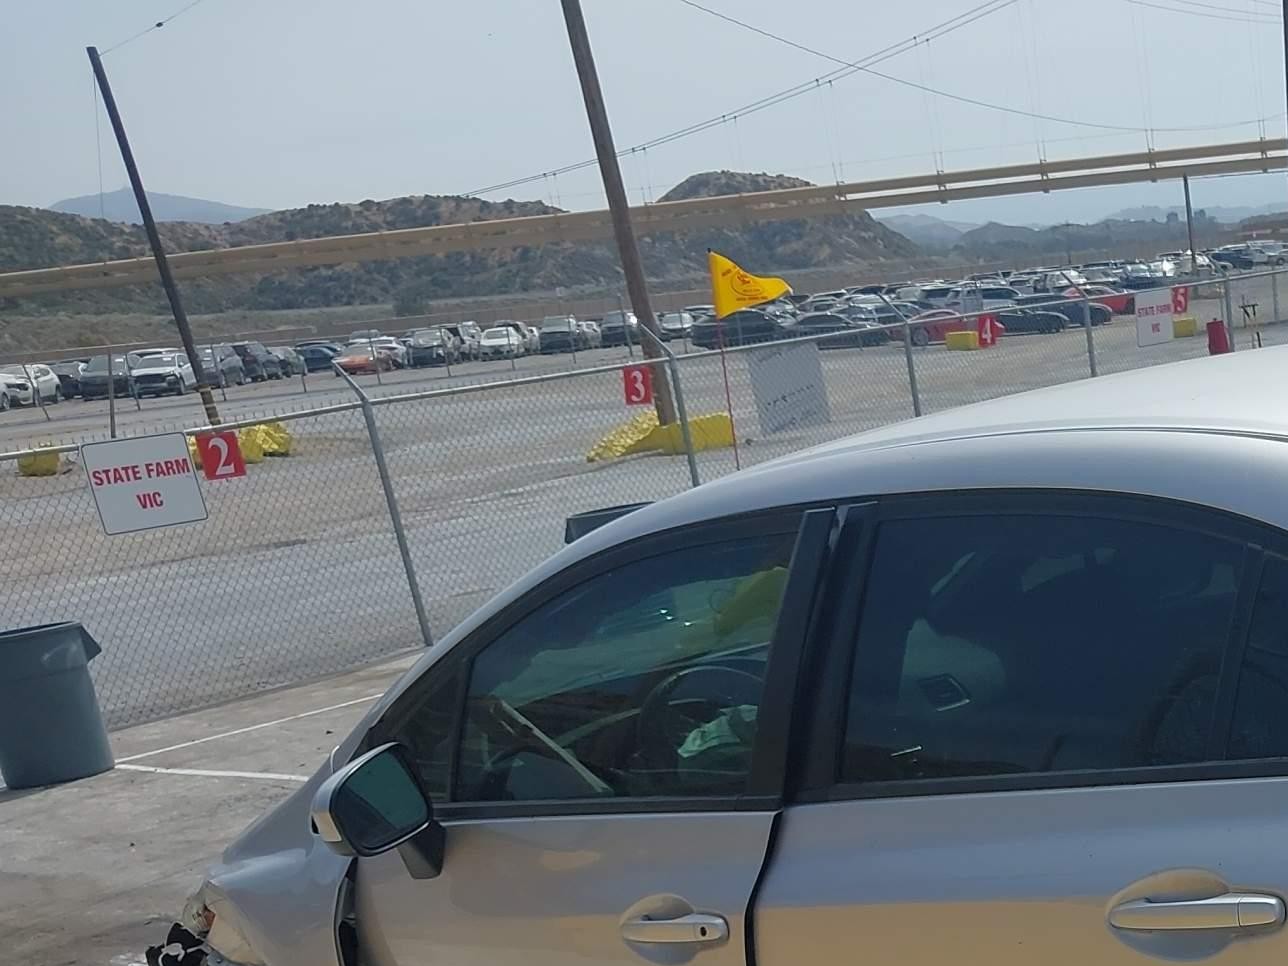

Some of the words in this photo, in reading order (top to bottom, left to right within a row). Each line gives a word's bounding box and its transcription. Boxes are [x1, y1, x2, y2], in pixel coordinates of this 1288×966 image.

[1176, 287, 1185, 312] 5
[982, 319, 991, 343] 4
[630, 369, 646, 402] 3
[208, 437, 235, 476] 2
[92, 465, 142, 486] STATE
[145, 458, 191, 478] FARM
[136, 491, 164, 509] VIC
